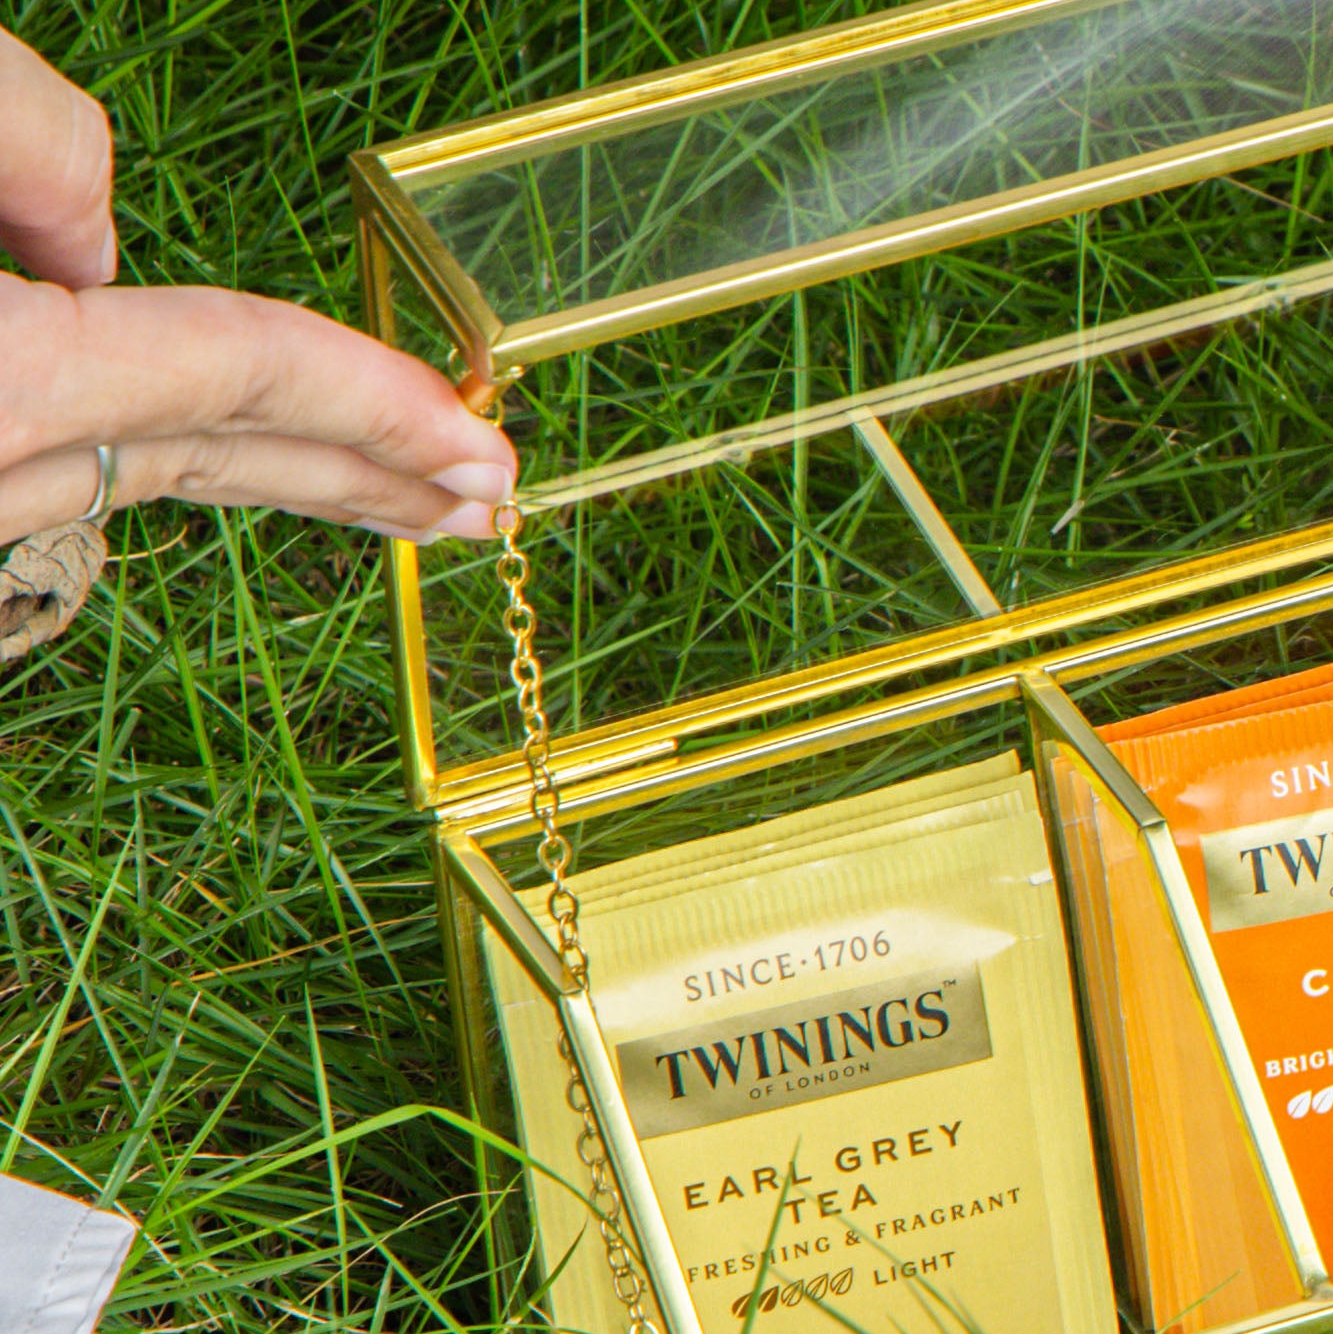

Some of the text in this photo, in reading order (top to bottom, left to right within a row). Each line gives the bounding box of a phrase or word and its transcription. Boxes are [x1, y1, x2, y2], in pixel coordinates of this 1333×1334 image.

[749, 1061, 871, 1100] OF LONDON
[683, 1120, 963, 1211] EARL GREY
[783, 1183, 878, 1225] TEA
[844, 1229, 862, 1246] &
[876, 1186, 1021, 1238] FRAGRANT
[873, 1250, 957, 1286] LIGHT
